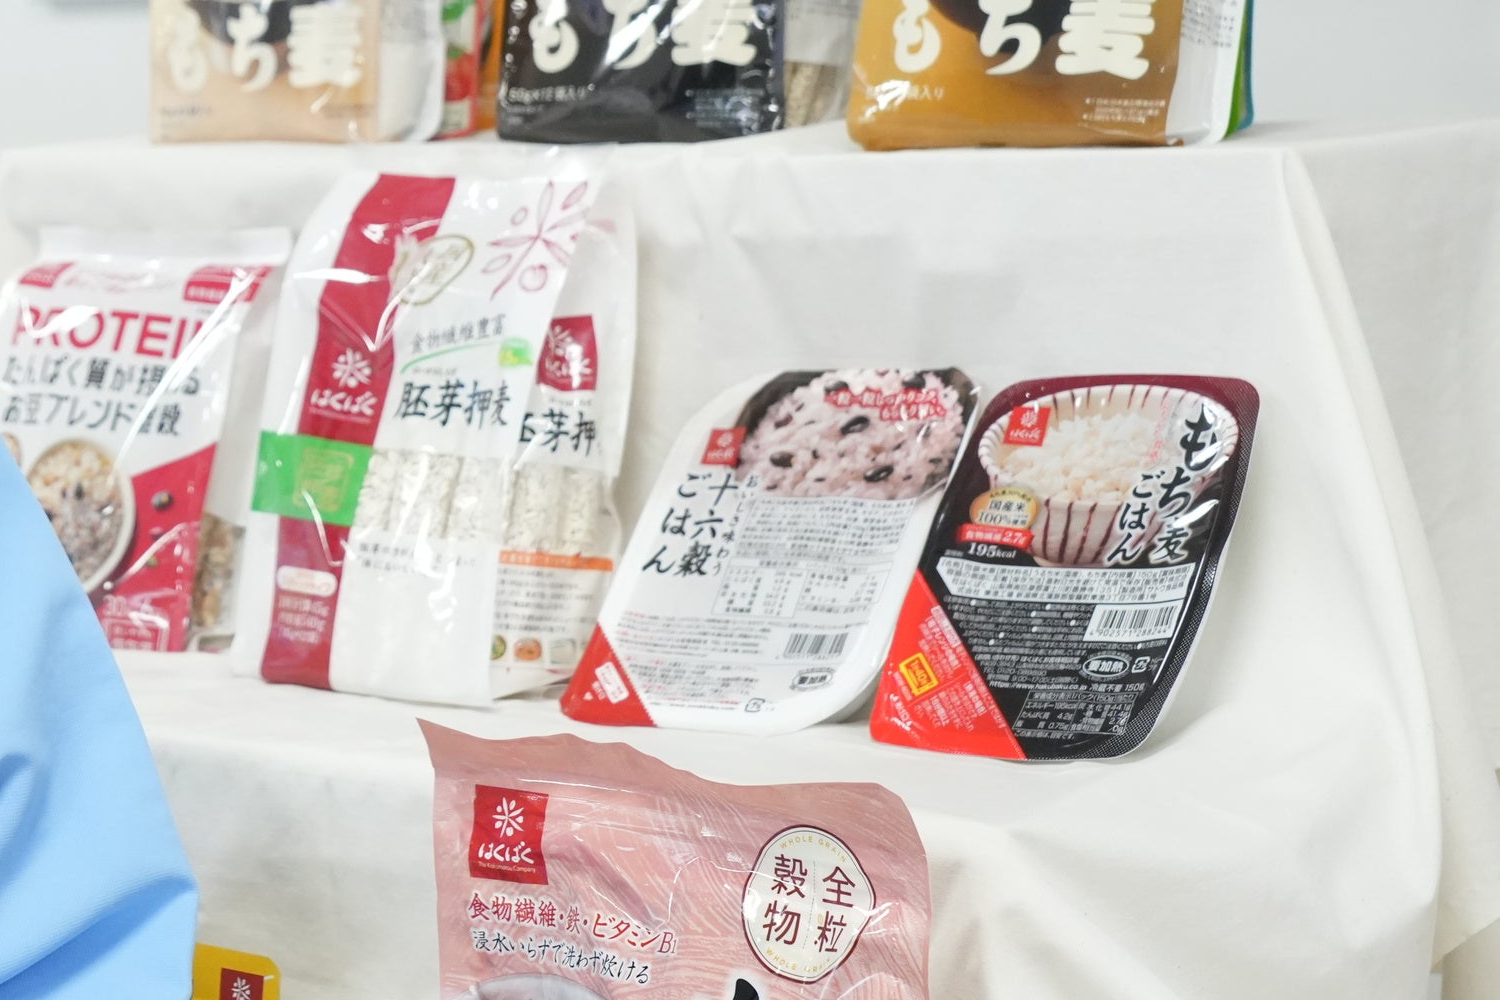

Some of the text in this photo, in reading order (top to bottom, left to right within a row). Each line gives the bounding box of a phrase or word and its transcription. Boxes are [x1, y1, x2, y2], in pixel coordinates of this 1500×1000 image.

[12, 303, 205, 360] PROTEI
[310, 388, 378, 417] はくばく
[395, 378, 511, 430] 胚芽押麦
[1153, 402, 1219, 560] もち麦
[641, 472, 712, 574] ごはん
[1106, 469, 1167, 563] ごはん
[967, 542, 1018, 559] 195kcal
[478, 841, 535, 865] はくばく
[779, 835, 848, 865] WHOLE GRAIN
[468, 892, 677, 955] 食物繊維・鉄・ビタミンB1
[762, 853, 808, 946] 穀物
[813, 866, 856, 953] 全粒
[471, 930, 650, 985] 浸水いらずで洗わず炊ける
[765, 946, 798, 972] WHOLE
